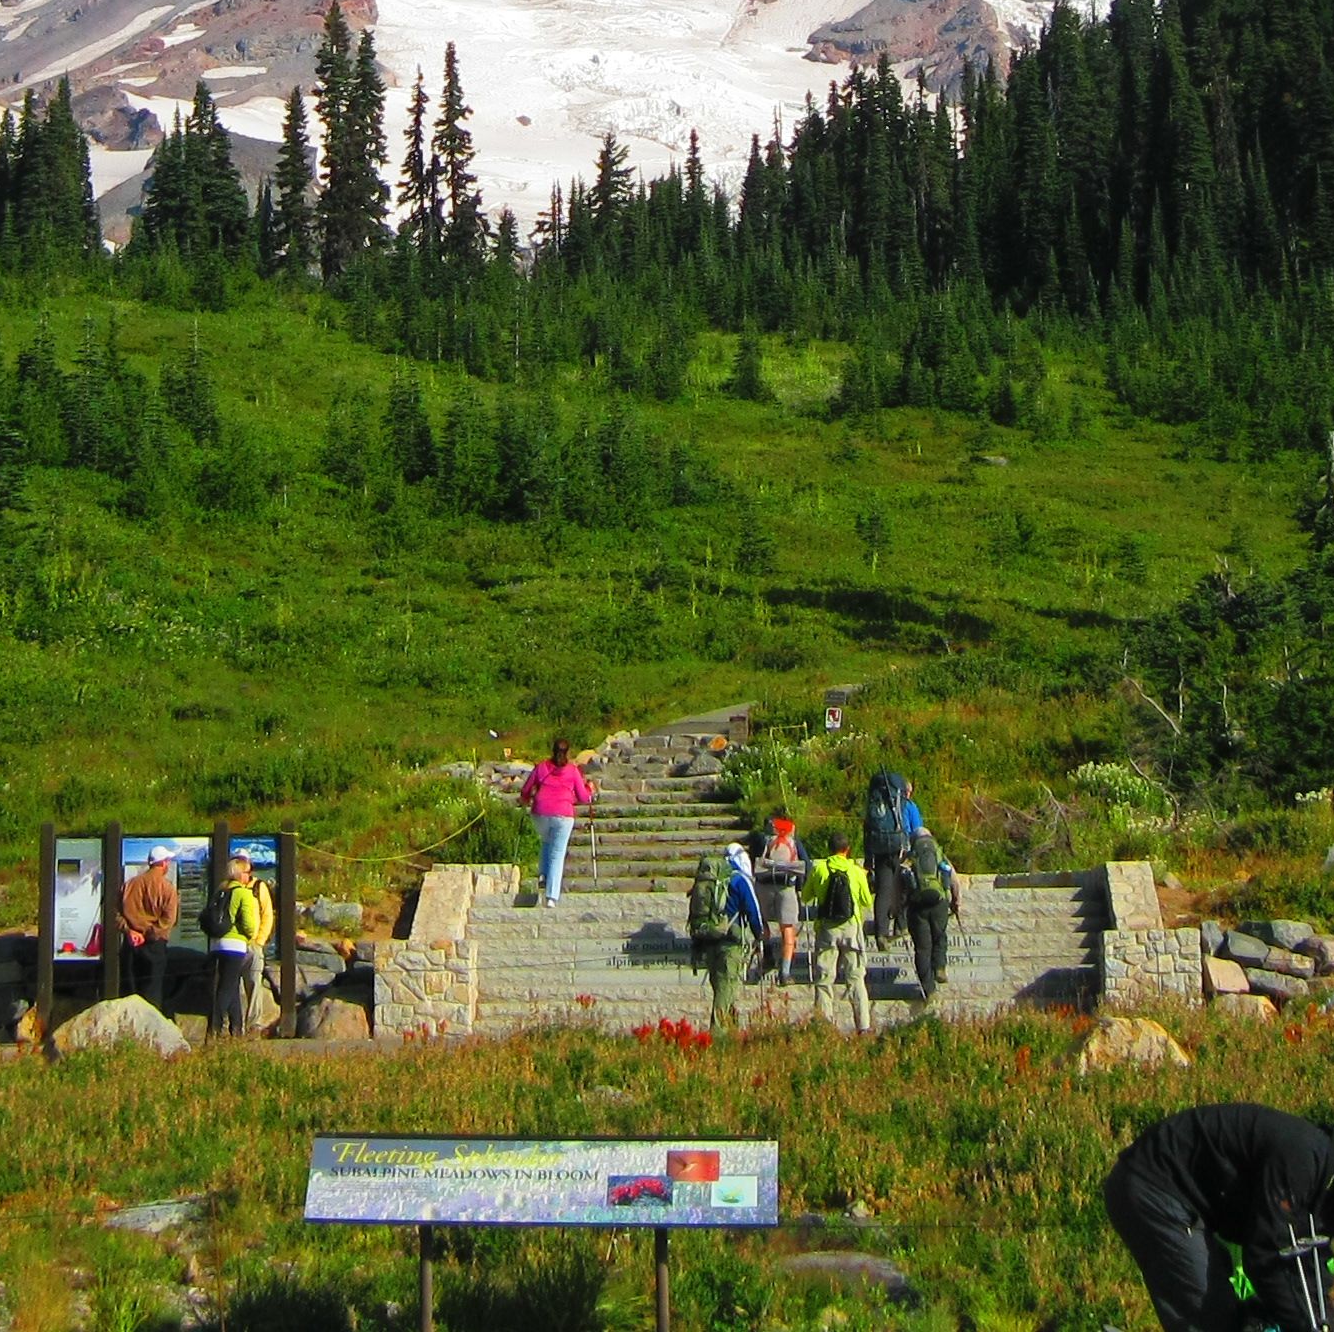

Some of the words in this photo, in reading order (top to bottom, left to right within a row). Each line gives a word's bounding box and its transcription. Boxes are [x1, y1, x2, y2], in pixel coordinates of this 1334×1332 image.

[605, 955, 640, 969] alpine
[642, 955, 686, 970] gardens
[331, 1141, 439, 1169] Fleeting
[330, 1166, 420, 1179] SUBALPINE
[423, 1167, 511, 1181] MEADOWS
[514, 1169, 533, 1181] IN
[537, 1169, 600, 1182] BLOOM
